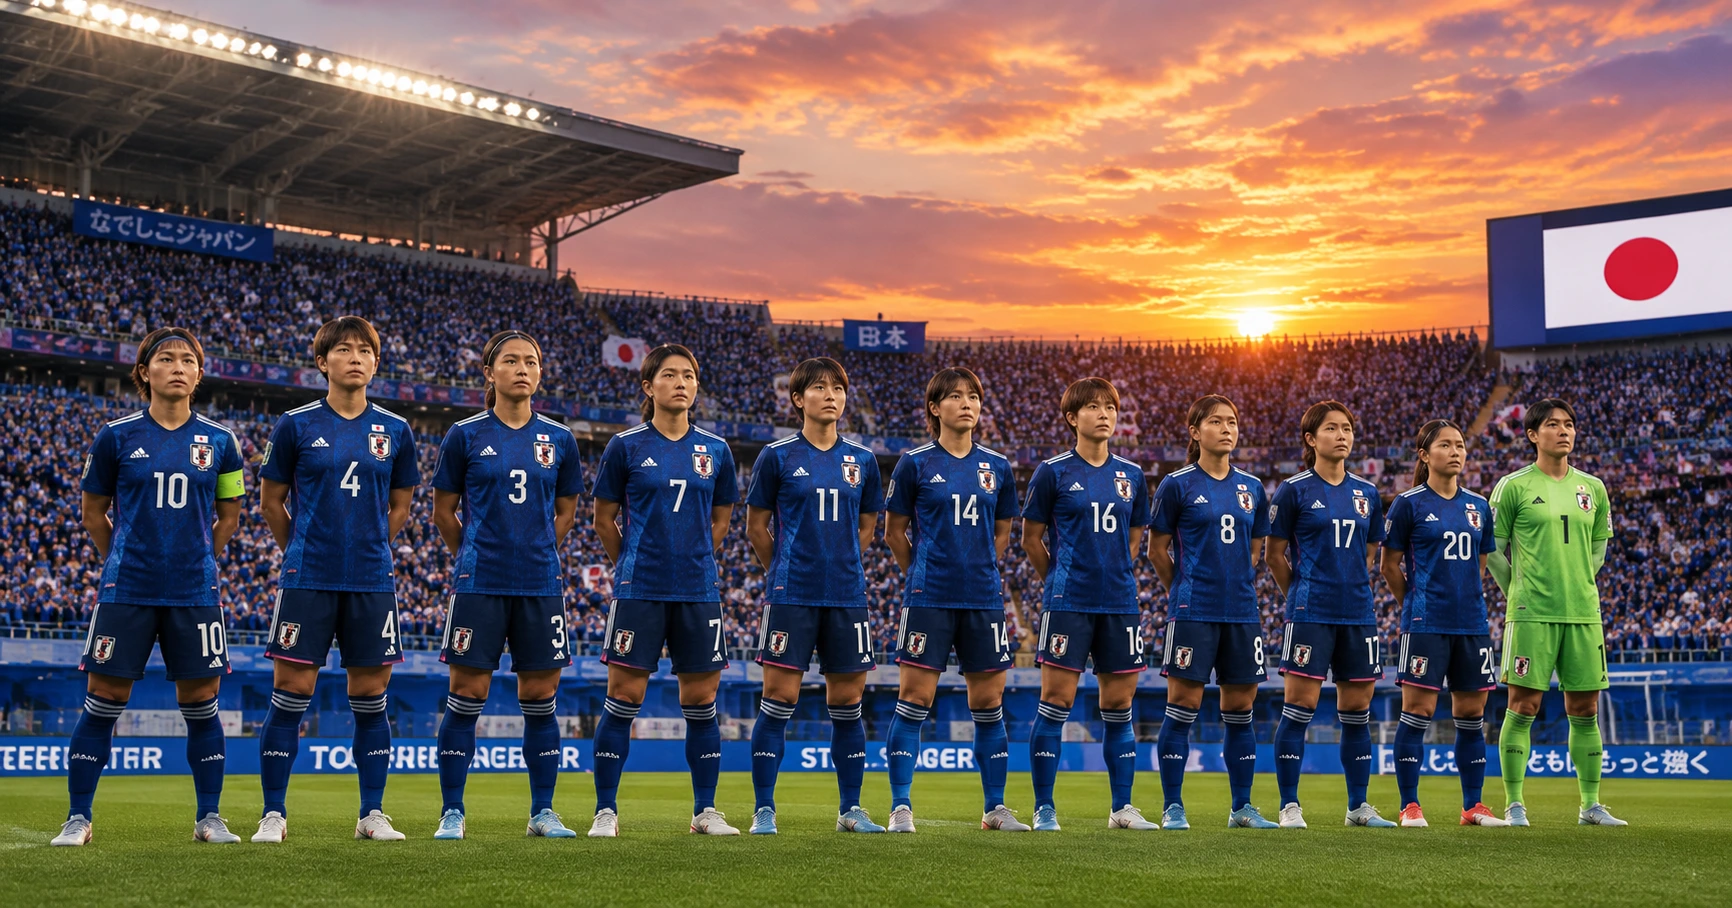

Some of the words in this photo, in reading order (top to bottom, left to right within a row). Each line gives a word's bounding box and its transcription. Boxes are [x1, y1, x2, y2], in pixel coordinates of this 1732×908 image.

[153, 472, 188, 508] 10
[340, 461, 360, 497] 4
[508, 468, 527, 504] 3
[670, 478, 687, 513] 7
[816, 488, 839, 521] 11
[952, 494, 979, 526] 14
[1091, 502, 1117, 533] 16
[1220, 514, 1236, 543] 8
[1332, 519, 1356, 548] 17
[1560, 515, 1570, 544] 1
[1443, 531, 1471, 560] 20
[197, 621, 224, 657] 10
[381, 611, 396, 645] 4
[551, 615, 565, 648] 3
[709, 619, 721, 652] 7
[854, 621, 871, 654] 11
[991, 621, 1010, 653] 14
[1126, 625, 1144, 656] 16
[1254, 635, 1264, 666] 8
[1598, 644, 1606, 673] 1
